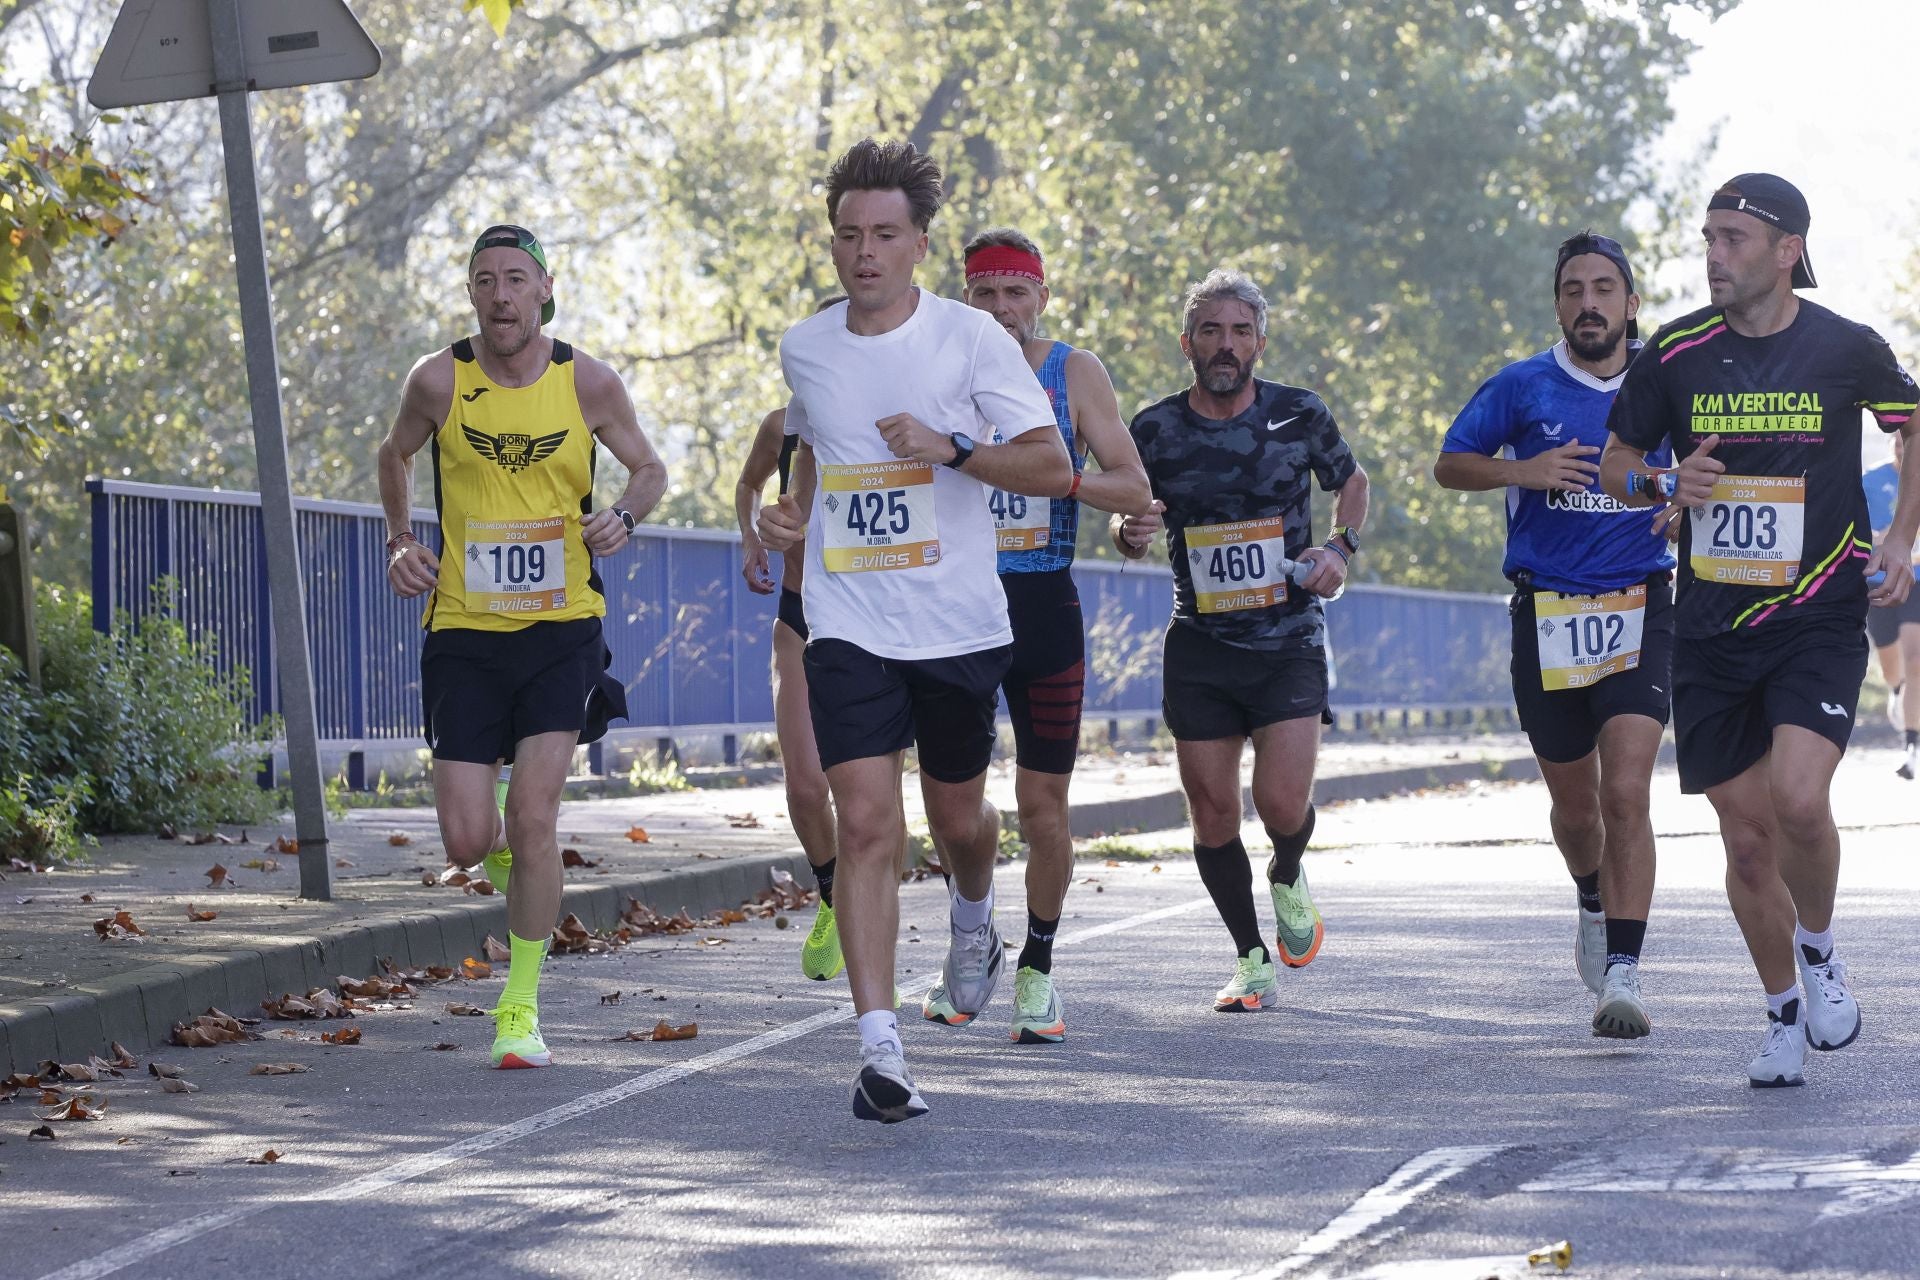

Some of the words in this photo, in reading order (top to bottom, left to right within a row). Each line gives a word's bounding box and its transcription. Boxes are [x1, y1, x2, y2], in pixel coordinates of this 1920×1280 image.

[1692, 393, 1724, 413] KM
[1727, 392, 1823, 413] VERTICAL
[1693, 416, 1819, 430] TORRELAVEGA
[500, 435, 529, 446] BORN
[500, 454, 529, 464] RUN
[840, 467, 861, 476] MEDIA
[862, 463, 901, 475] MARATÓN
[860, 477, 884, 487] 2024
[1736, 477, 1775, 487] MARATÓN
[1776, 478, 1804, 488] AVILÉS
[1731, 489, 1756, 498] 2024
[847, 490, 910, 536] 425
[486, 522, 508, 530] MEDIA
[508, 520, 543, 530] MARATÓN
[543, 518, 562, 528] AVILÉS
[1203, 526, 1224, 534] MEDIA
[1224, 521, 1258, 531] MARATÓN
[1258, 518, 1280, 527] AVILÉS
[1712, 503, 1777, 550] 203
[505, 532, 528, 540] 2024
[1222, 533, 1243, 541] 2024
[1707, 547, 1783, 560] @SUPERPAPADEMELLIZAS
[489, 544, 545, 584] 109
[851, 551, 911, 569] avilés
[1209, 543, 1266, 583] 460
[1620, 588, 1645, 597] VILÉS
[1580, 602, 1604, 610] 2024
[1564, 614, 1625, 657] 102
[1587, 656, 1599, 665] ETA
